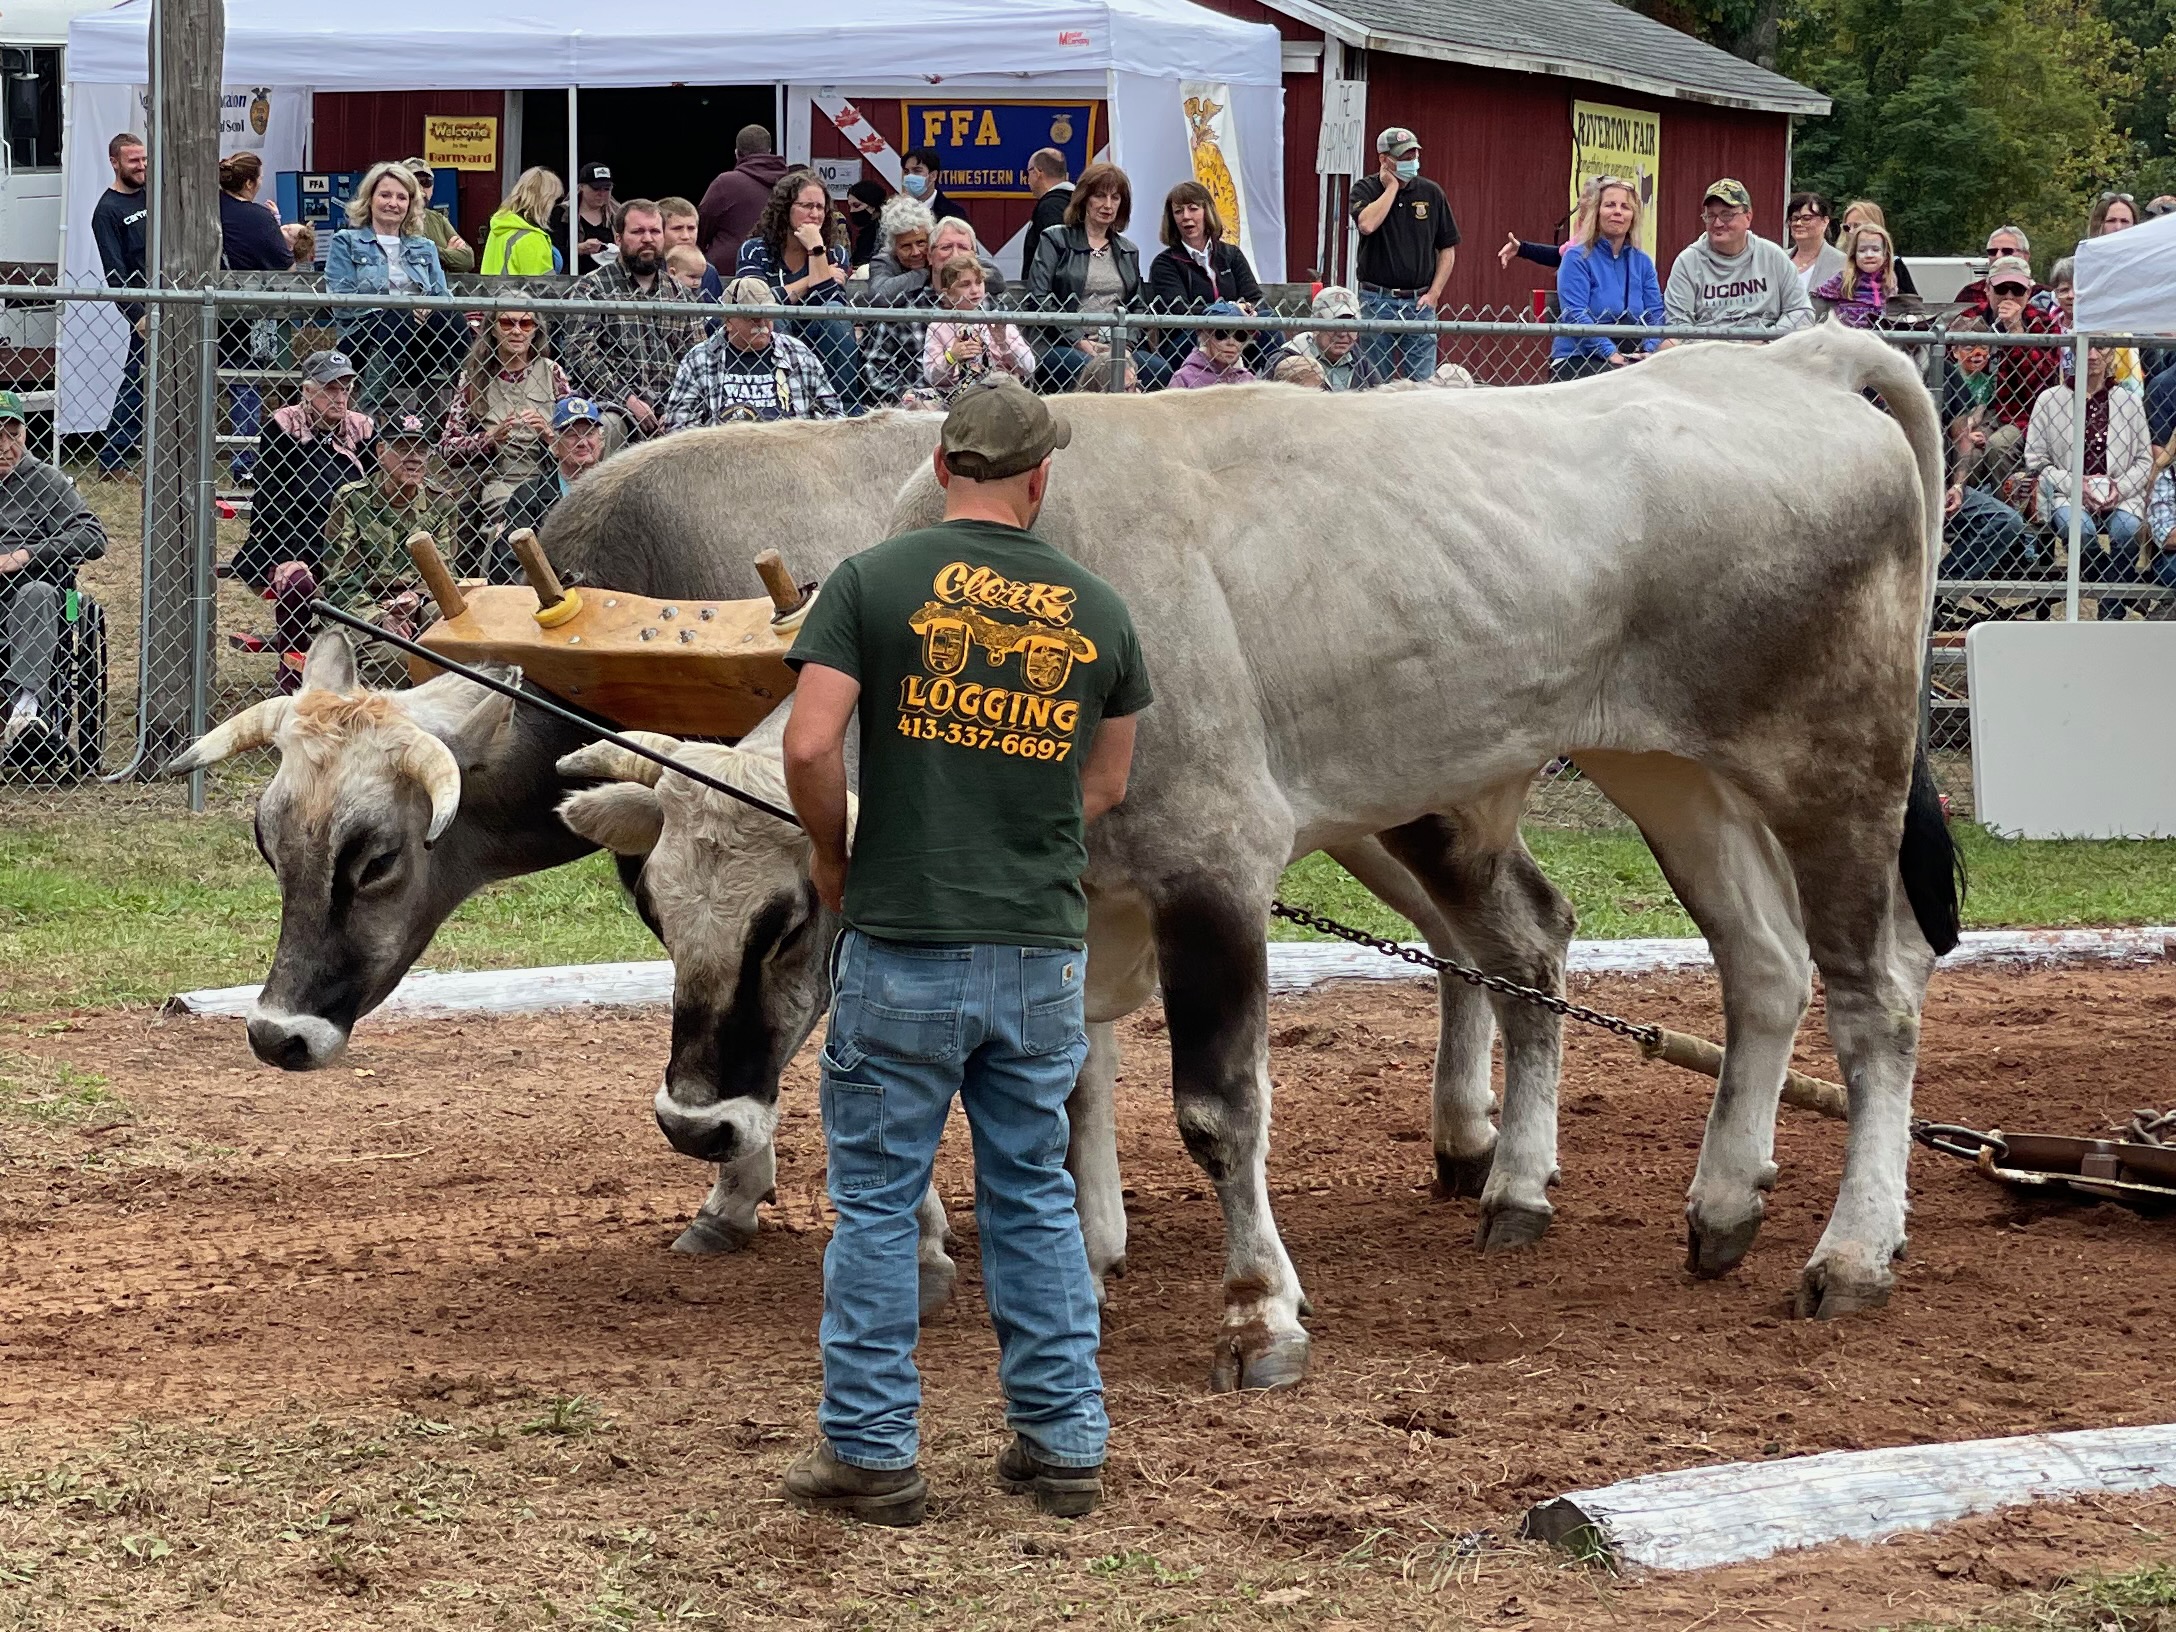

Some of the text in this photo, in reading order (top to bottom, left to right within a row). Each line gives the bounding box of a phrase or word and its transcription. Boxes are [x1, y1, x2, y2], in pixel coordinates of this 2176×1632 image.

[434, 124, 489, 137] Welcome
[922, 109, 1001, 147] FFA
[1577, 111, 1656, 156] RIVERTON FAIR
[429, 152, 492, 164] Barnyard
[819, 166, 837, 180] NO
[309, 180, 325, 189] FFA
[1703, 278, 1767, 299] UCONN
[723, 383, 776, 400] WALK
[897, 674, 1080, 739] LOGGING
[897, 713, 1072, 762] 413-337-6697
